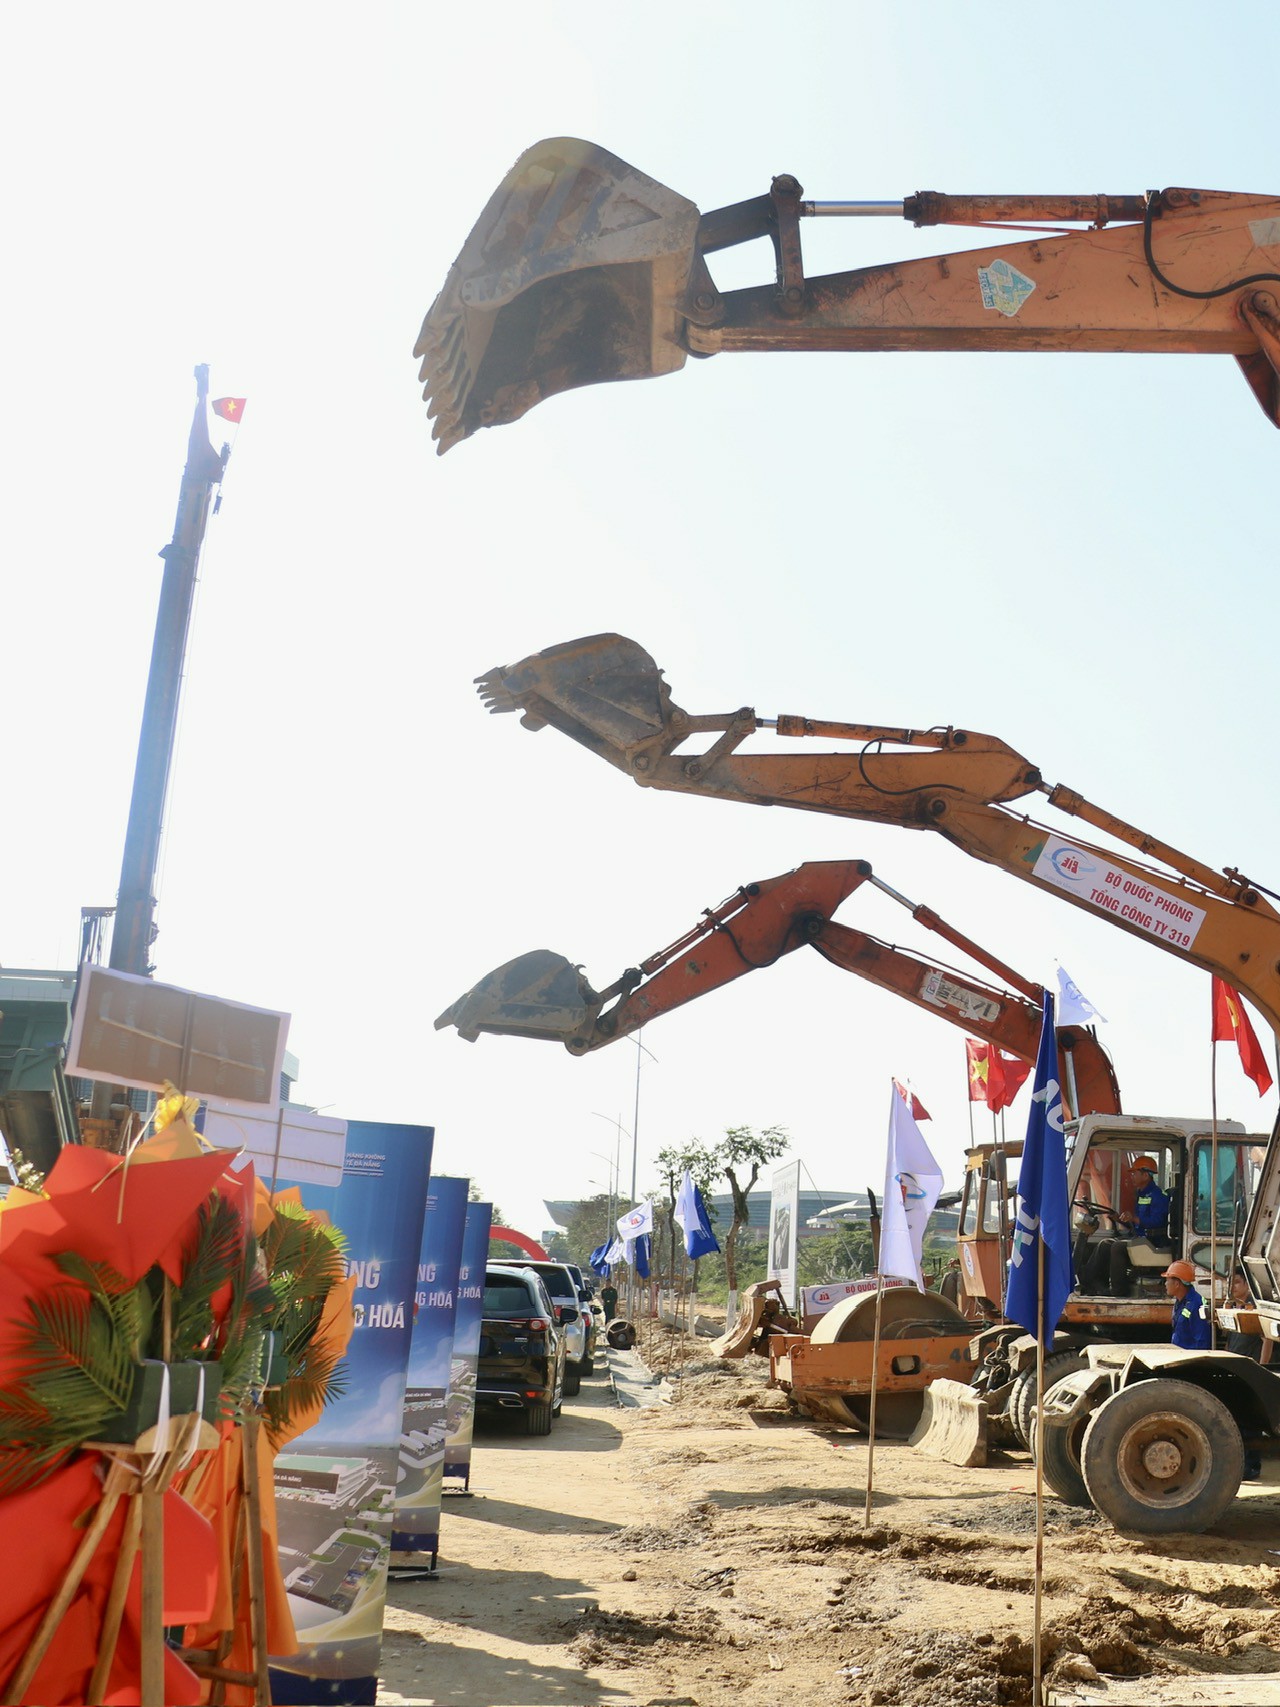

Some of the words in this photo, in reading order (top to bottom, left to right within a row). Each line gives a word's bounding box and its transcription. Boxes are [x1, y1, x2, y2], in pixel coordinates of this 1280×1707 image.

[1104, 871, 1123, 889] BỘ
[1123, 881, 1154, 903] QUỐC
[1154, 895, 1194, 923] PHÒNG
[1090, 888, 1119, 912] TỔNG
[1121, 904, 1153, 929] CÔNG
[1153, 920, 1169, 936] TY
[1168, 928, 1191, 947] 319
[343, 1260, 381, 1289] NG
[417, 1264, 436, 1282] NG
[429, 1291, 453, 1308] HOÁ
[463, 1285, 481, 1299] HOÁ
[845, 1286, 856, 1295] BỘ
[368, 1302, 405, 1329] HOÁ
